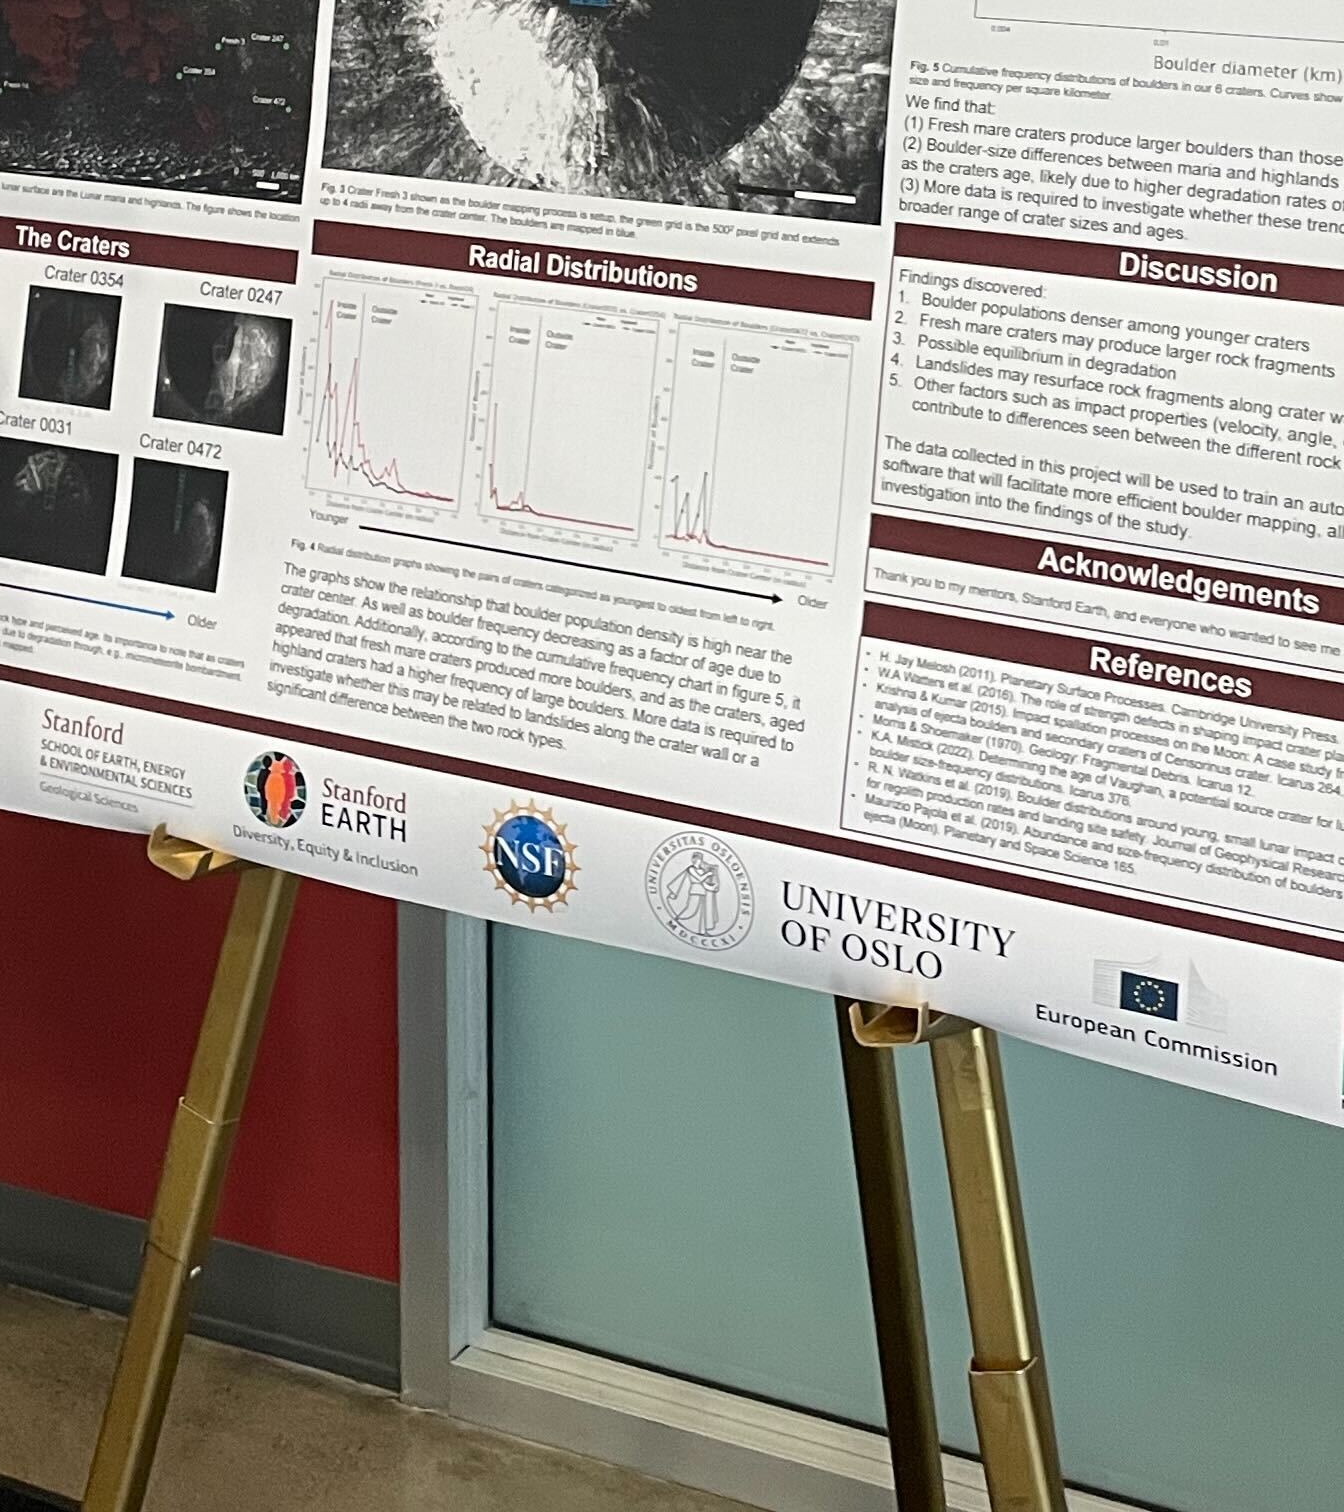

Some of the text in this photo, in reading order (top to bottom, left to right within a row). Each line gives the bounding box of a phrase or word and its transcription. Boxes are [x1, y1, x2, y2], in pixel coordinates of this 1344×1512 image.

[1153, 55, 1342, 84] Boulder diameter (km)
[15, 224, 130, 258] The Craters
[44, 264, 124, 288] Crater 0354
[468, 244, 698, 292] Radial Distributions
[1119, 251, 1277, 292] Discussion
[199, 281, 283, 305] Crater 0247
[39, 416, 72, 435] 0031
[139, 433, 222, 460] Crater 0472
[309, 508, 349, 526] Younger
[1037, 546, 1319, 614] Acknowledgements
[797, 594, 828, 609] Older
[187, 613, 217, 630] Older
[1090, 646, 1252, 698] References
[42, 708, 124, 745] Stanford
[39, 754, 192, 799] & ENVIRONMENTAL SCIENCES
[40, 738, 186, 780] SCHOOL OF EARTH, ENERGY
[39, 781, 139, 813] Geological Sciences
[322, 777, 406, 814] Stanford
[322, 802, 406, 843] EARTH
[232, 824, 418, 877] Diversity, Equity & Inclusion
[495, 836, 563, 877] NSF
[782, 881, 1015, 957] UNIVERSITY
[781, 919, 942, 979] OF OSLO
[1036, 1003, 1277, 1076] European Commission
